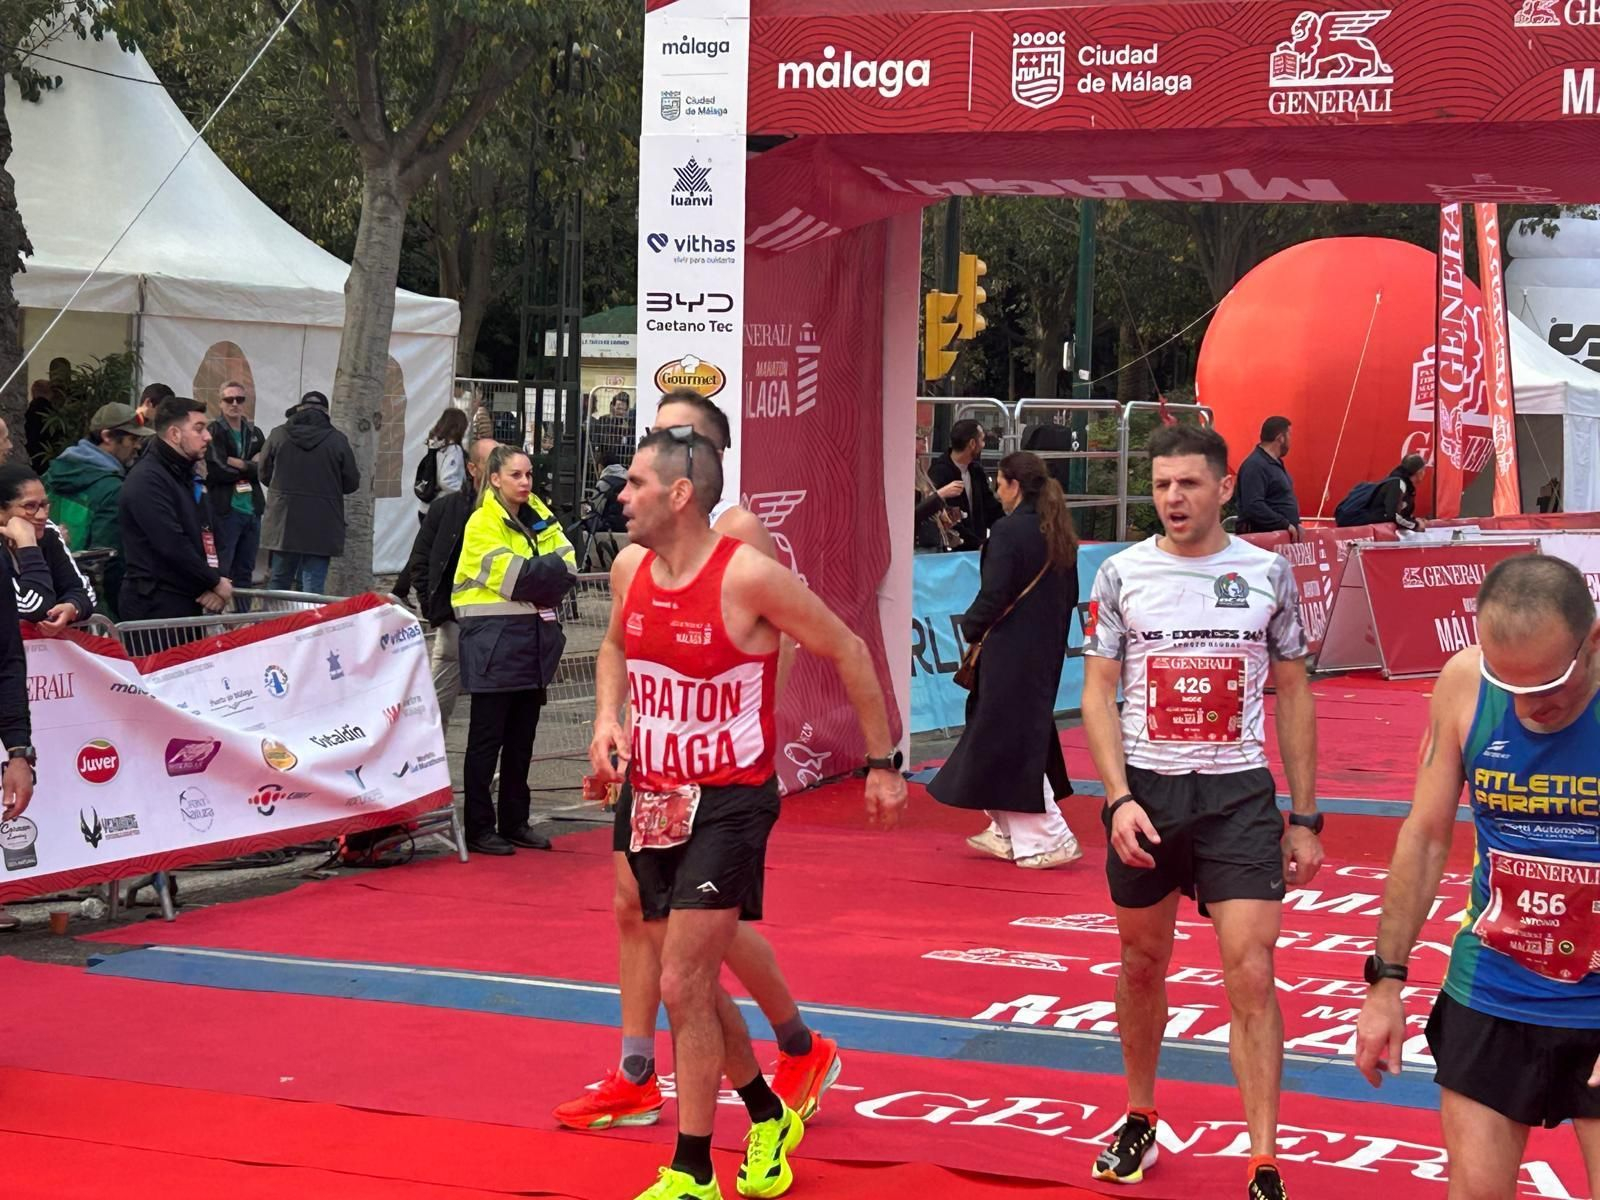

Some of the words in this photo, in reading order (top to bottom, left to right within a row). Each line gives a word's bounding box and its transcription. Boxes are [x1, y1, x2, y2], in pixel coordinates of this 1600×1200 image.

[1078, 44, 1158, 66] Ciudad
[1077, 74, 1106, 93] de
[1111, 71, 1192, 95] Málaga
[685, 96, 716, 105] Ciudad
[1268, 89, 1393, 115] GENERALI
[671, 194, 713, 207] luanvi
[674, 234, 736, 253] vithas
[646, 292, 734, 313] BYD
[646, 319, 706, 333] Caetano
[709, 320, 734, 333] Tec
[662, 371, 719, 386] Gourmet
[1172, 658, 1232, 670] GENERALI
[1174, 678, 1211, 694] 426
[80, 755, 117, 774] Juver
[1516, 889, 1567, 916] 456
